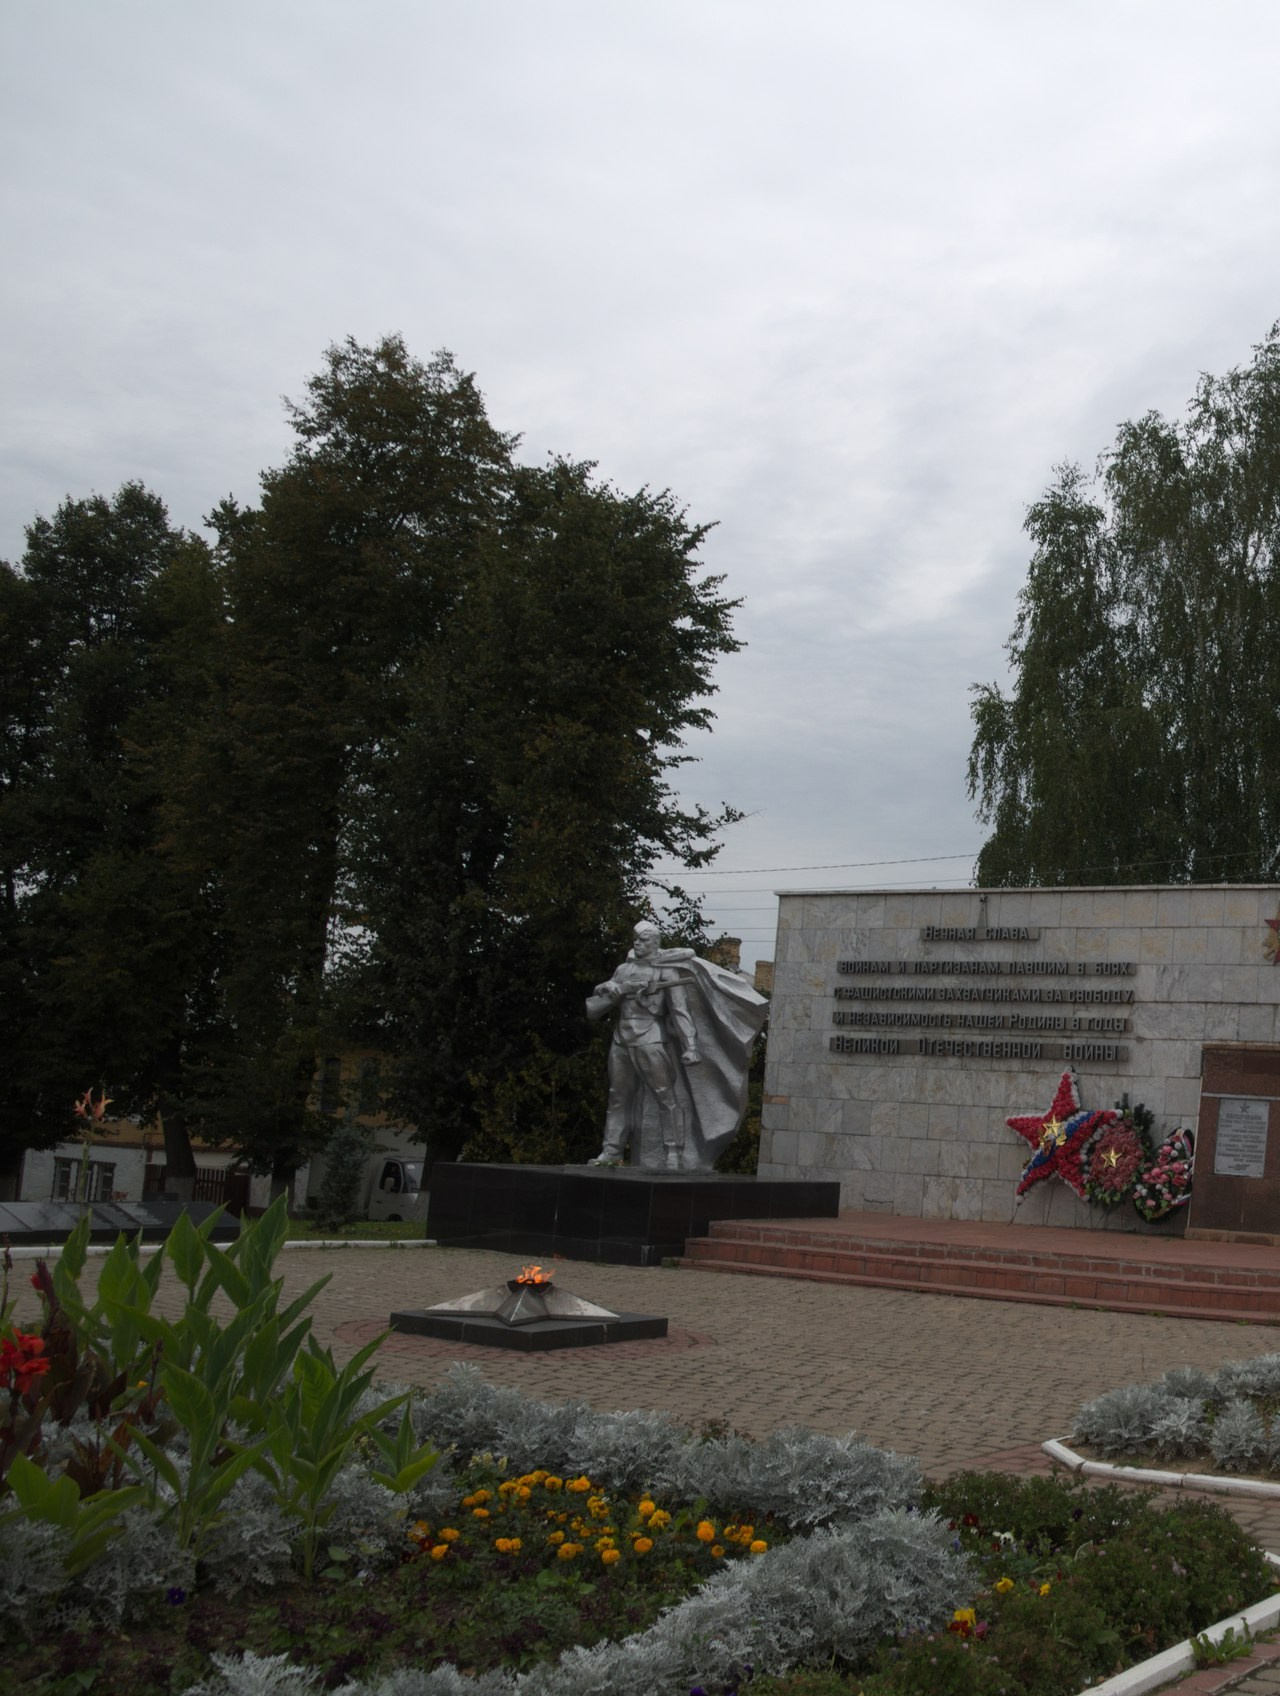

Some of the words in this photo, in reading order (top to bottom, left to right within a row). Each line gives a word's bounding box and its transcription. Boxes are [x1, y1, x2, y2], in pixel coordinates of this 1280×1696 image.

[984, 927, 1029, 941] СЛАВА
[841, 961, 890, 974] ВОИНАМ
[899, 961, 906, 973] И
[1008, 962, 1068, 975] ПАВШИМ
[1077, 963, 1086, 975] В
[1095, 962, 1130, 975] БОЯХ
[844, 987, 936, 1000] ФАШИСТСКИМИ
[938, 988, 1041, 1001] ЗАХВАТЧИКАМИ
[1047, 990, 1063, 1002] ЗА
[1069, 990, 1133, 1003] СВОБОДУ
[836, 1012, 845, 1024] И
[850, 1012, 951, 1026] НЕЗАВИСИМОСТЬ
[1010, 1013, 1067, 1029] РОДИНЫ
[1072, 1017, 1081, 1029] В
[1088, 1016, 1126, 1031] ГОДЫ
